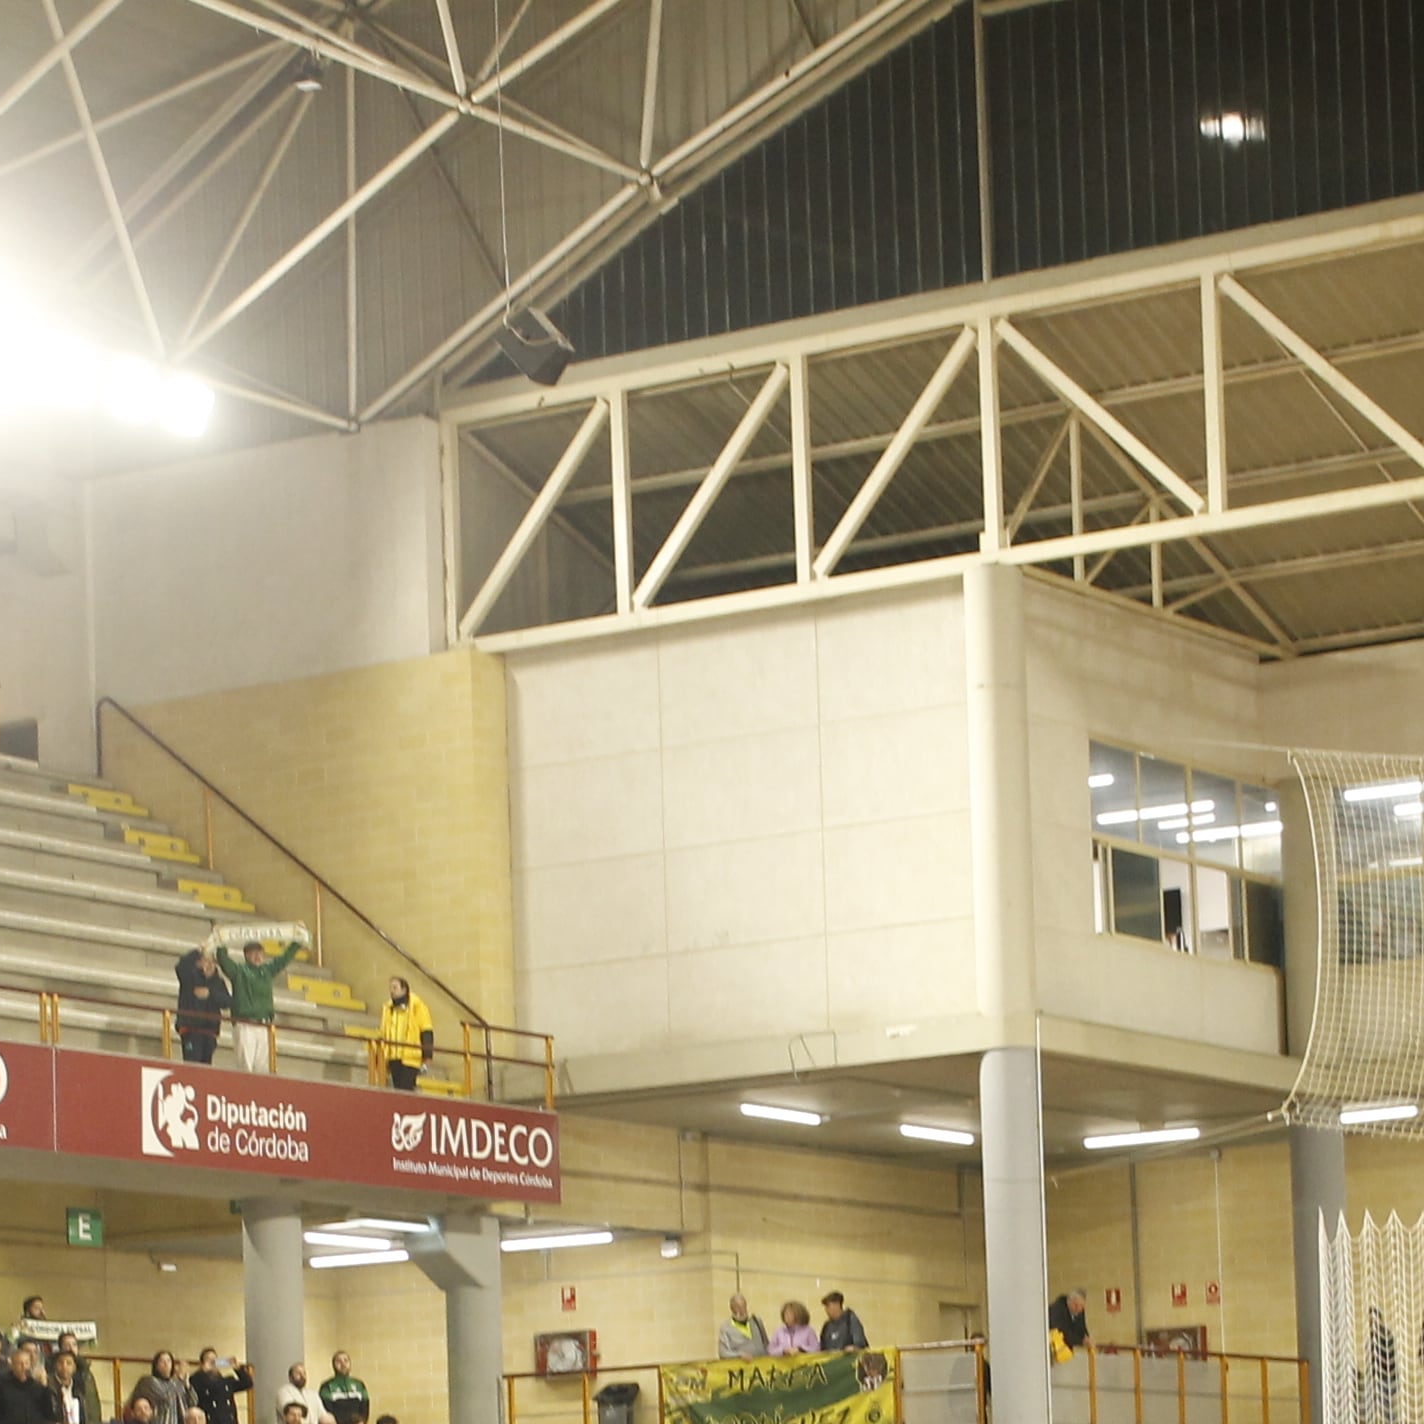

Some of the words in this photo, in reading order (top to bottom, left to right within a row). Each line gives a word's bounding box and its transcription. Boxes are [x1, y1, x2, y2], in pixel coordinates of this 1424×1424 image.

[206, 1093, 308, 1133] Diputación
[206, 1126, 232, 1154] de
[234, 1129, 310, 1163] Córdoba
[429, 1112, 554, 1169] IMDECO
[392, 1156, 428, 1176] Instituto
[428, 1160, 469, 1183] Municipal
[470, 1166, 481, 1181] de
[481, 1167, 519, 1187] Deportes
[519, 1172, 554, 1190] Córdoba
[77, 1213, 93, 1242] E
